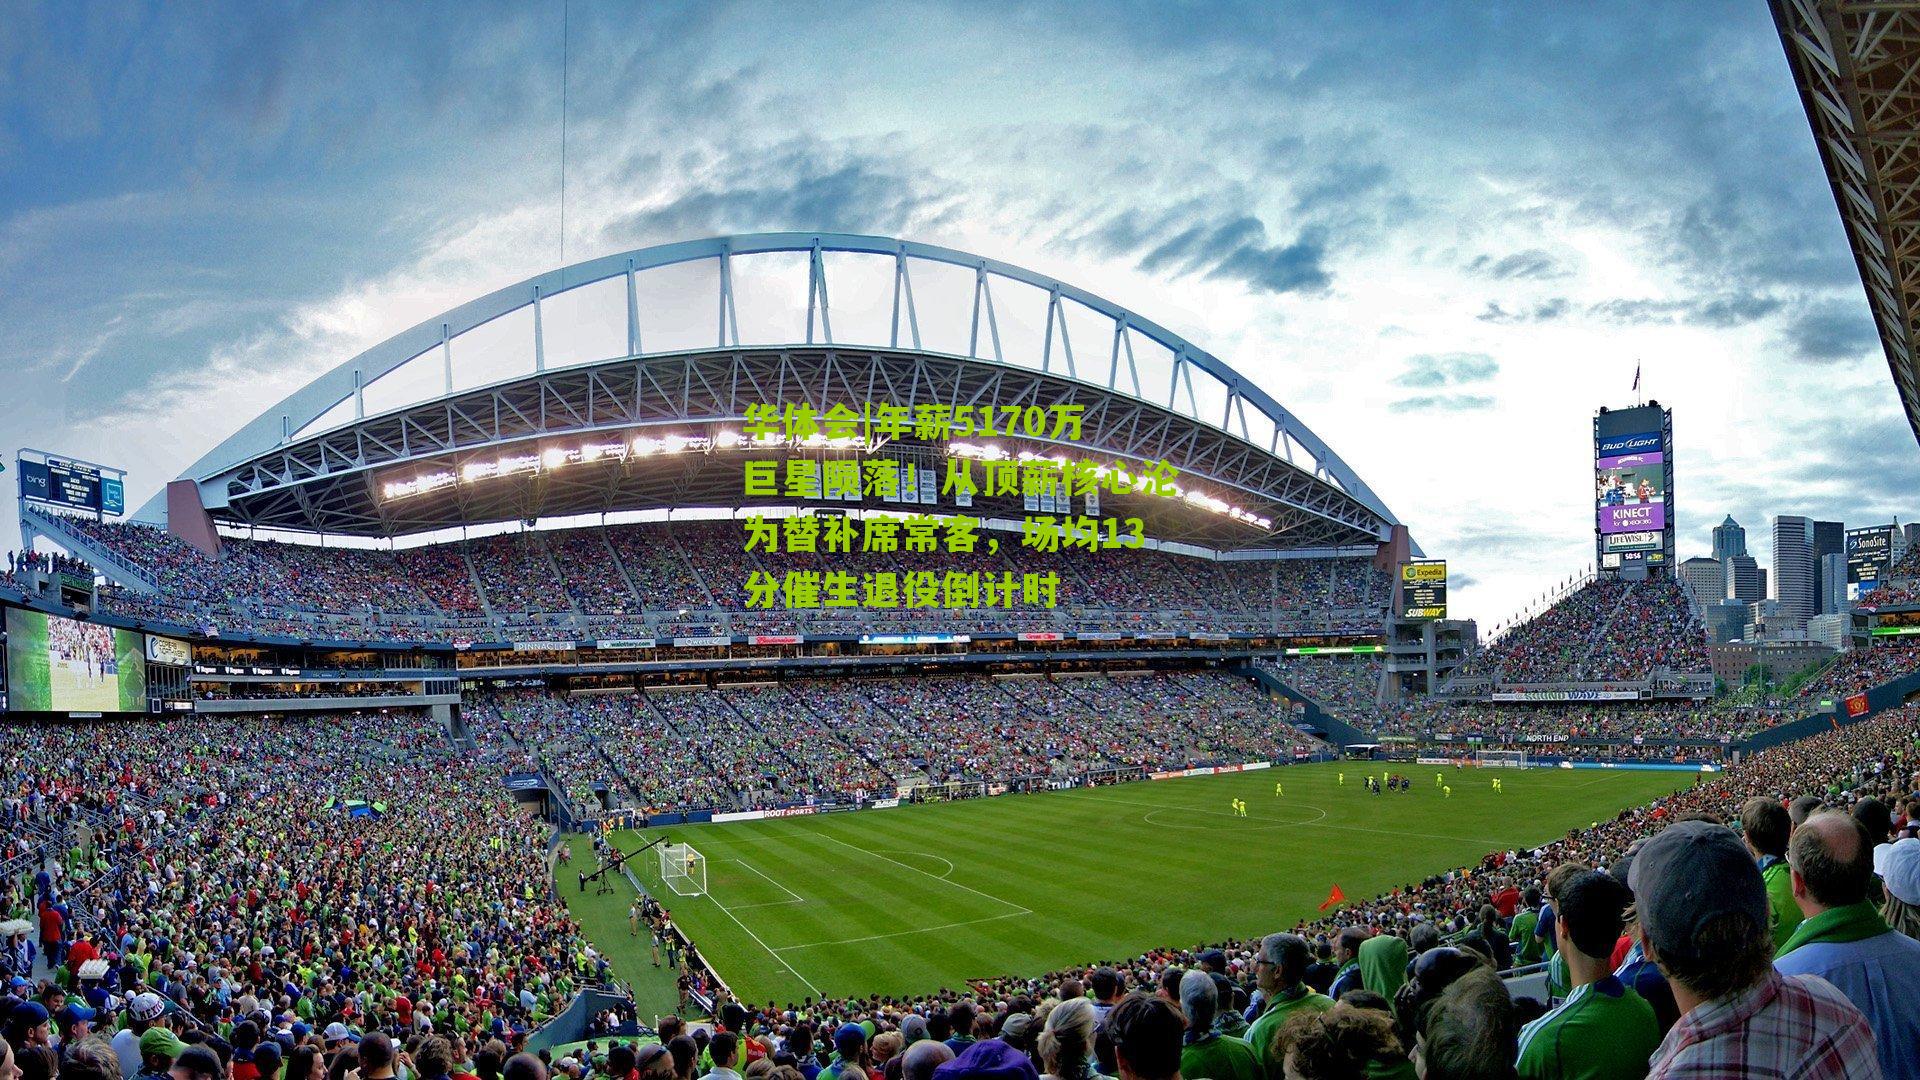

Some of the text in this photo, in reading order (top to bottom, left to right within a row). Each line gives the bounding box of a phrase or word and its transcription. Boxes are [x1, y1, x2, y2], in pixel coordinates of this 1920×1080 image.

[1629, 439, 1659, 448] LIGHT
[26, 474, 46, 488] bing
[1613, 507, 1653, 520] KINECT
[1858, 535, 1887, 549] SonoSite
[1416, 568, 1442, 577] Expedia
[1405, 608, 1445, 618] SUBWAY
[518, 642, 565, 651] PINNACLE
[1526, 734, 1570, 742] NORTH END
[763, 807, 814, 818] ROOT SPORTS
